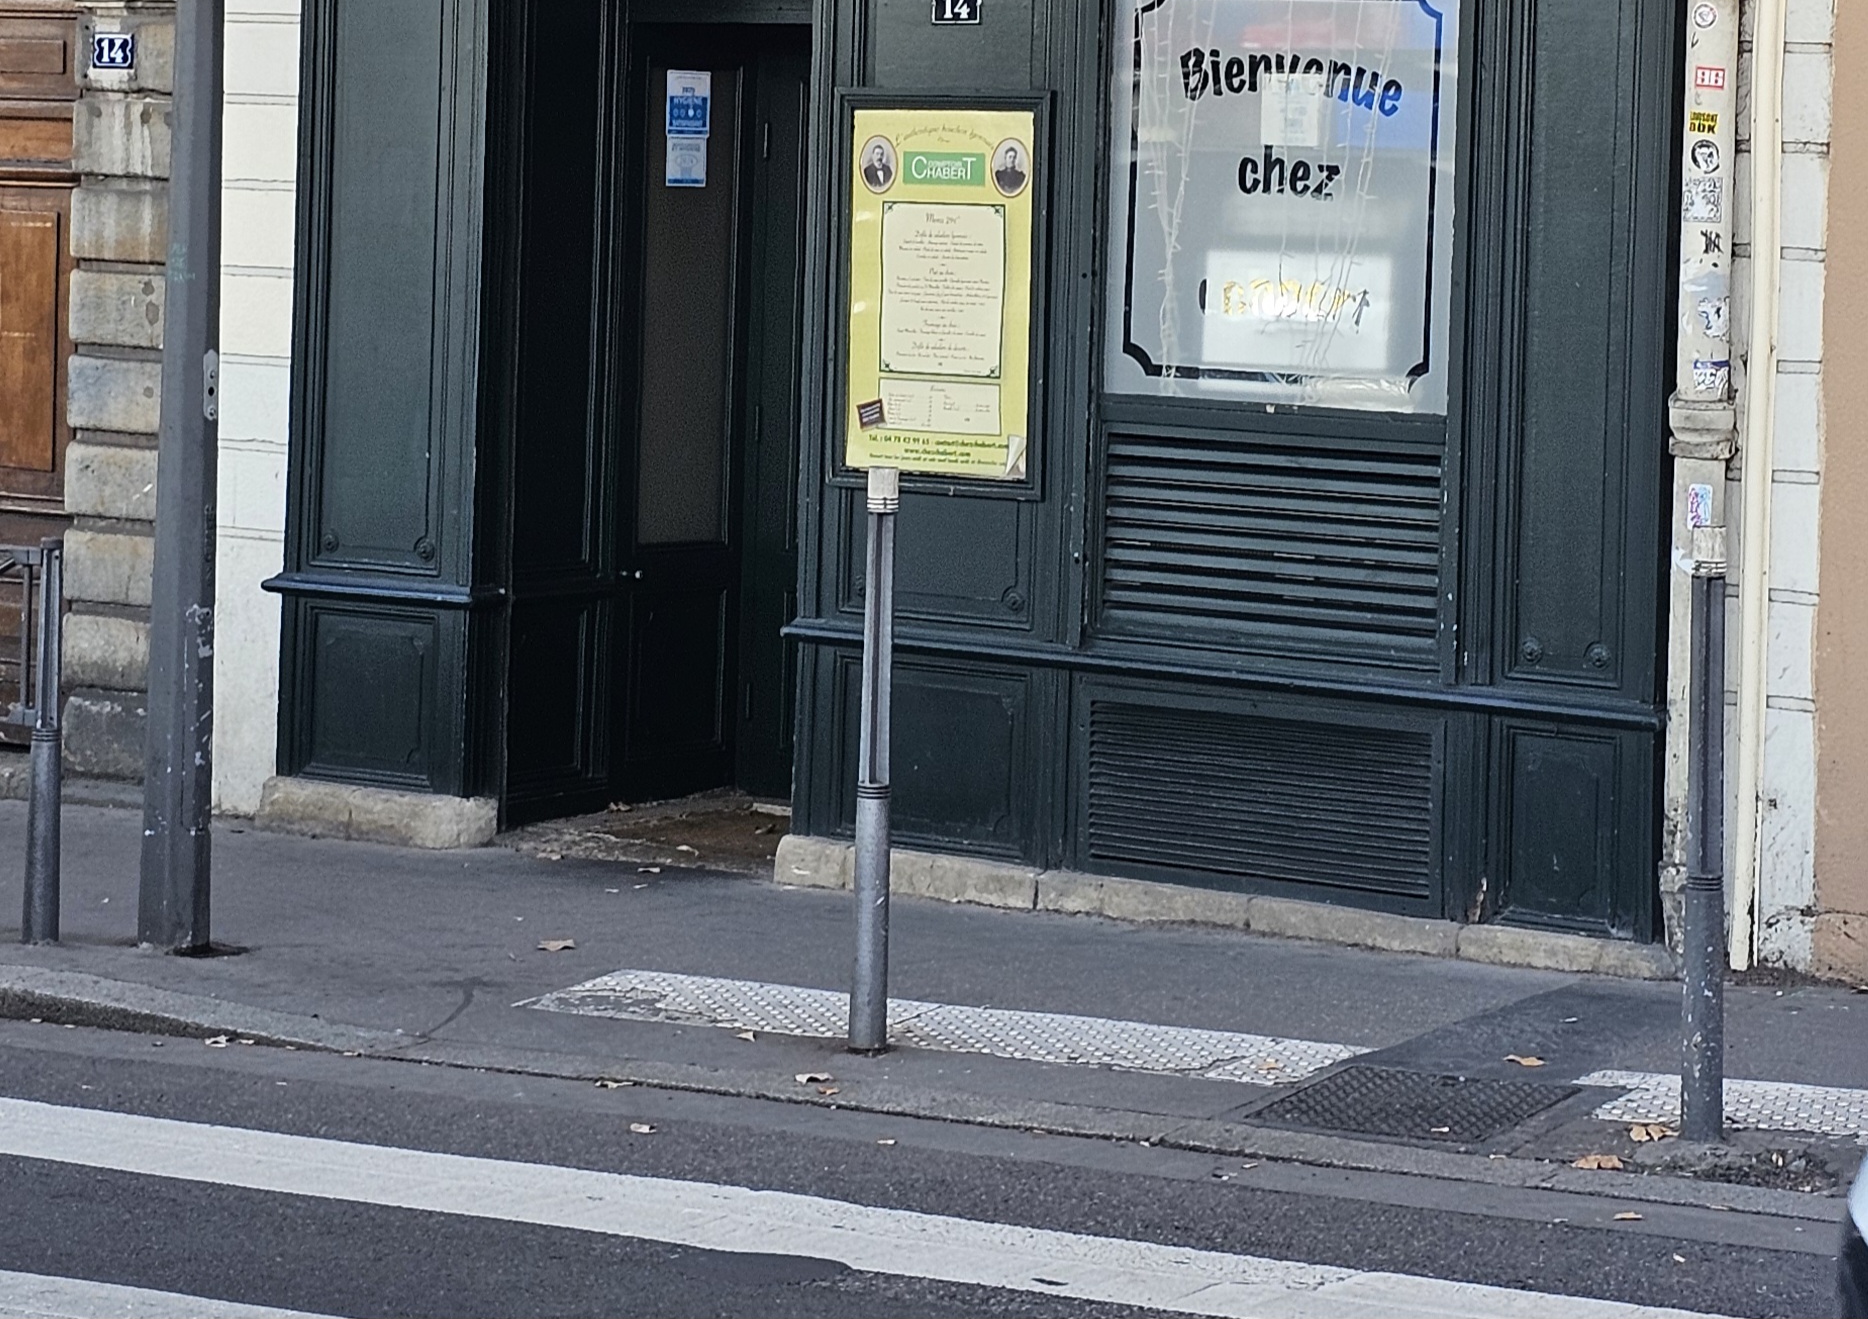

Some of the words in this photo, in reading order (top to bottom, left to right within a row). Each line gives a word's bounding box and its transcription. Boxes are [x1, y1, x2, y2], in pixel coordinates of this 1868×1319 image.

[100, 37, 125, 64] 14
[911, 155, 977, 181] CHABERT
[1238, 145, 1343, 202] chez
